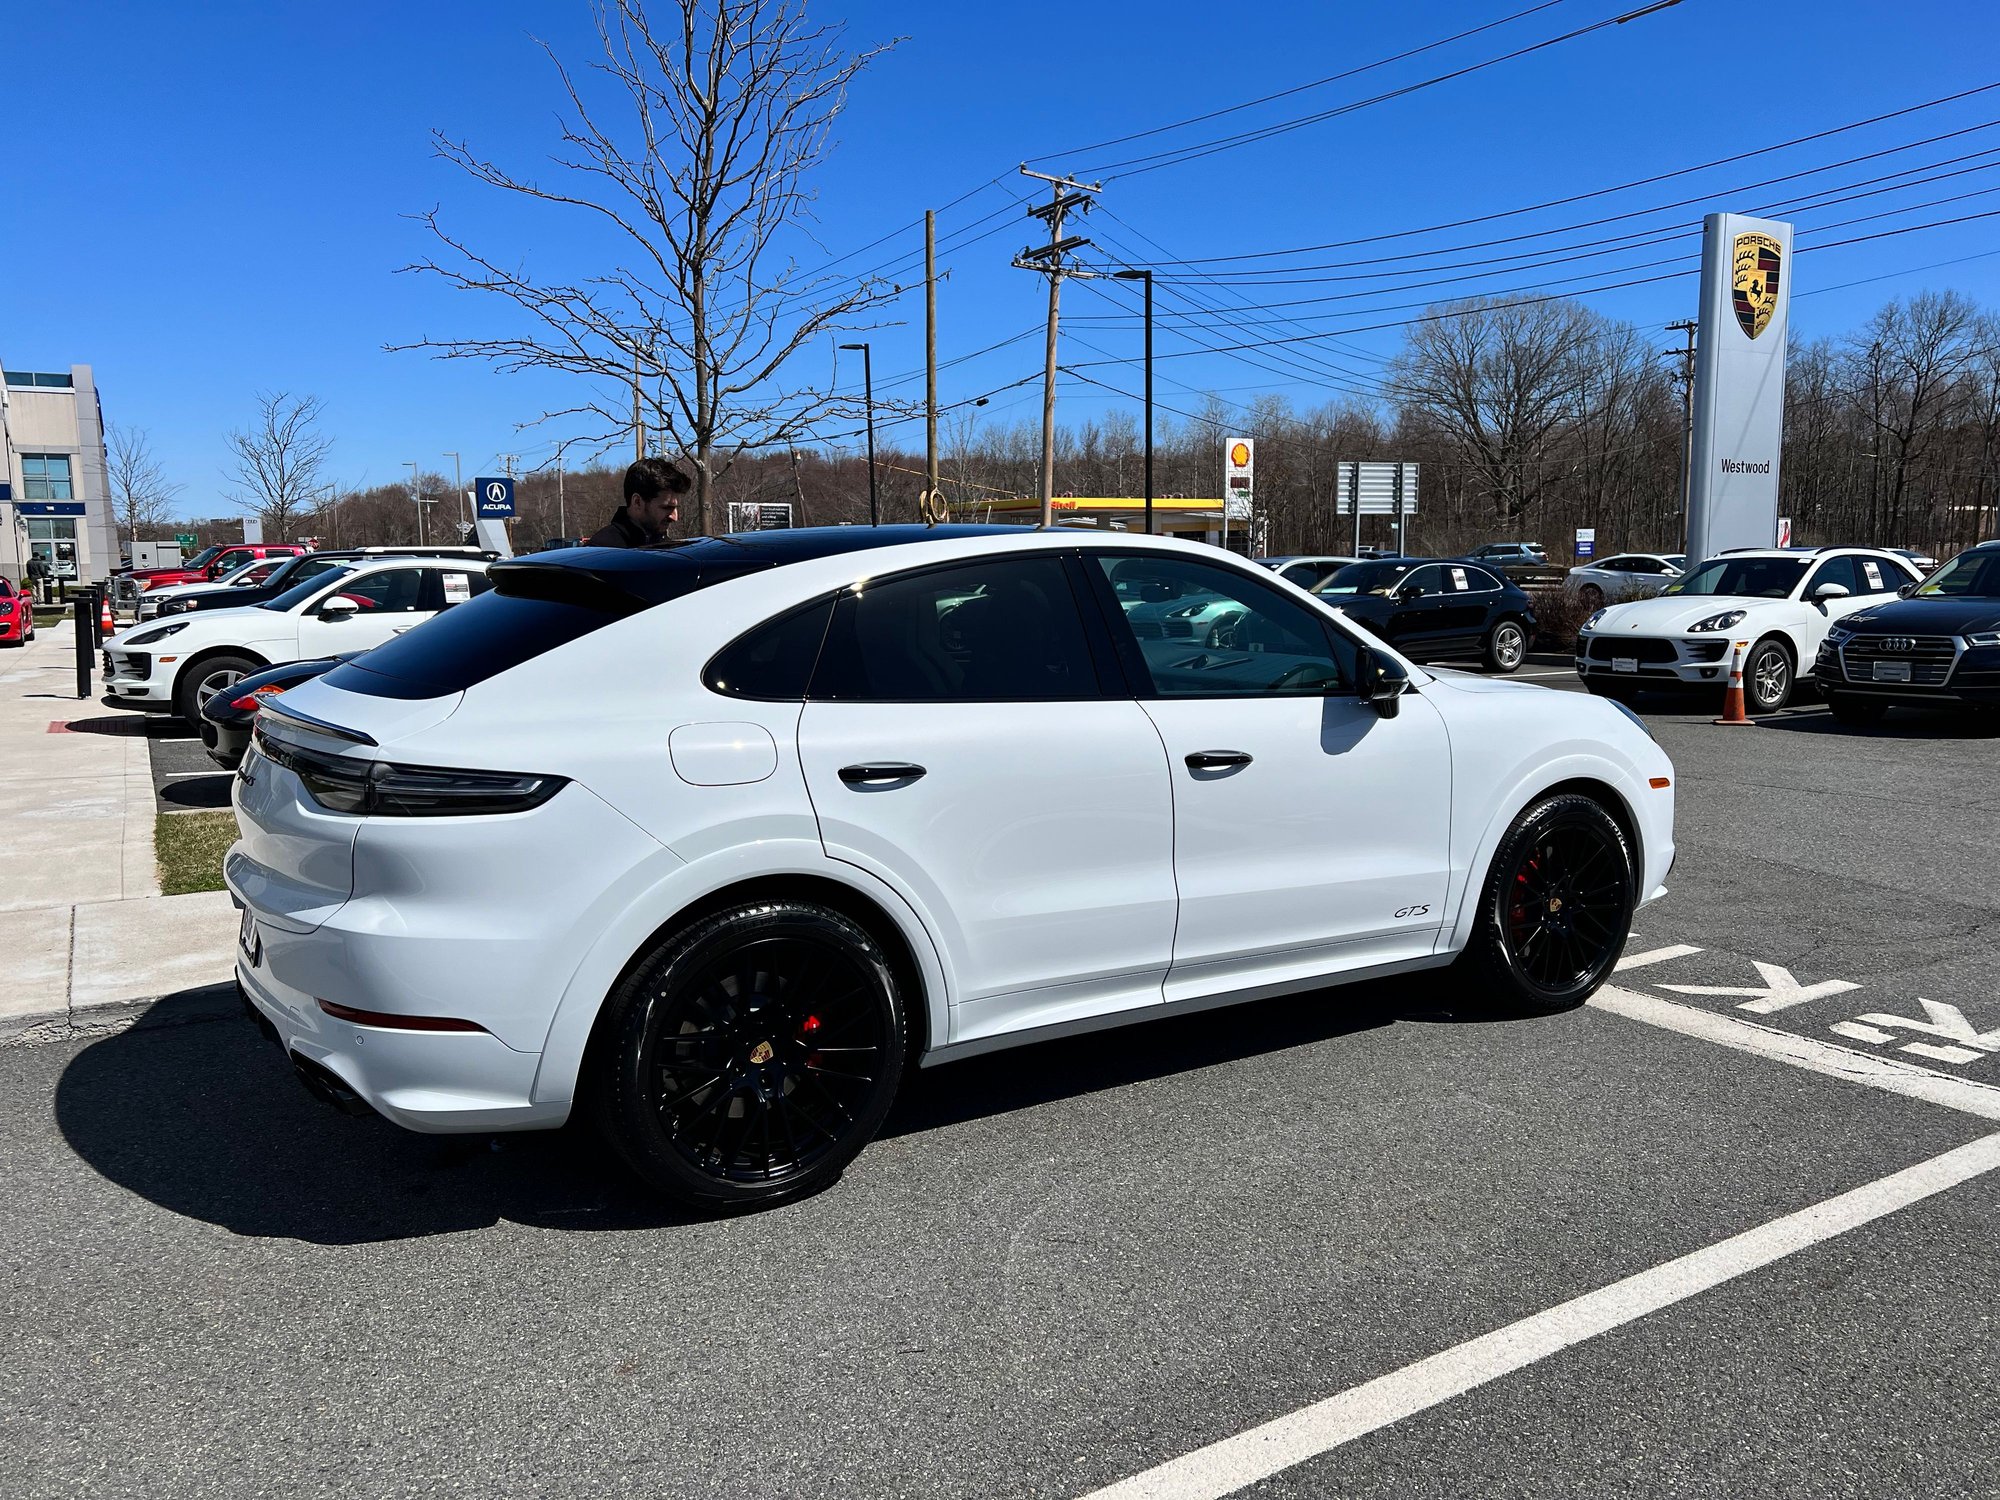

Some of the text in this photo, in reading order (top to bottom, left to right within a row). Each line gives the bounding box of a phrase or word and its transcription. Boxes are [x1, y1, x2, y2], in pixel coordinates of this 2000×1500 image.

[1736, 236, 1781, 254] PORSCHE
[1721, 458, 1770, 474] Westwood
[1394, 904, 1431, 918] GTS
